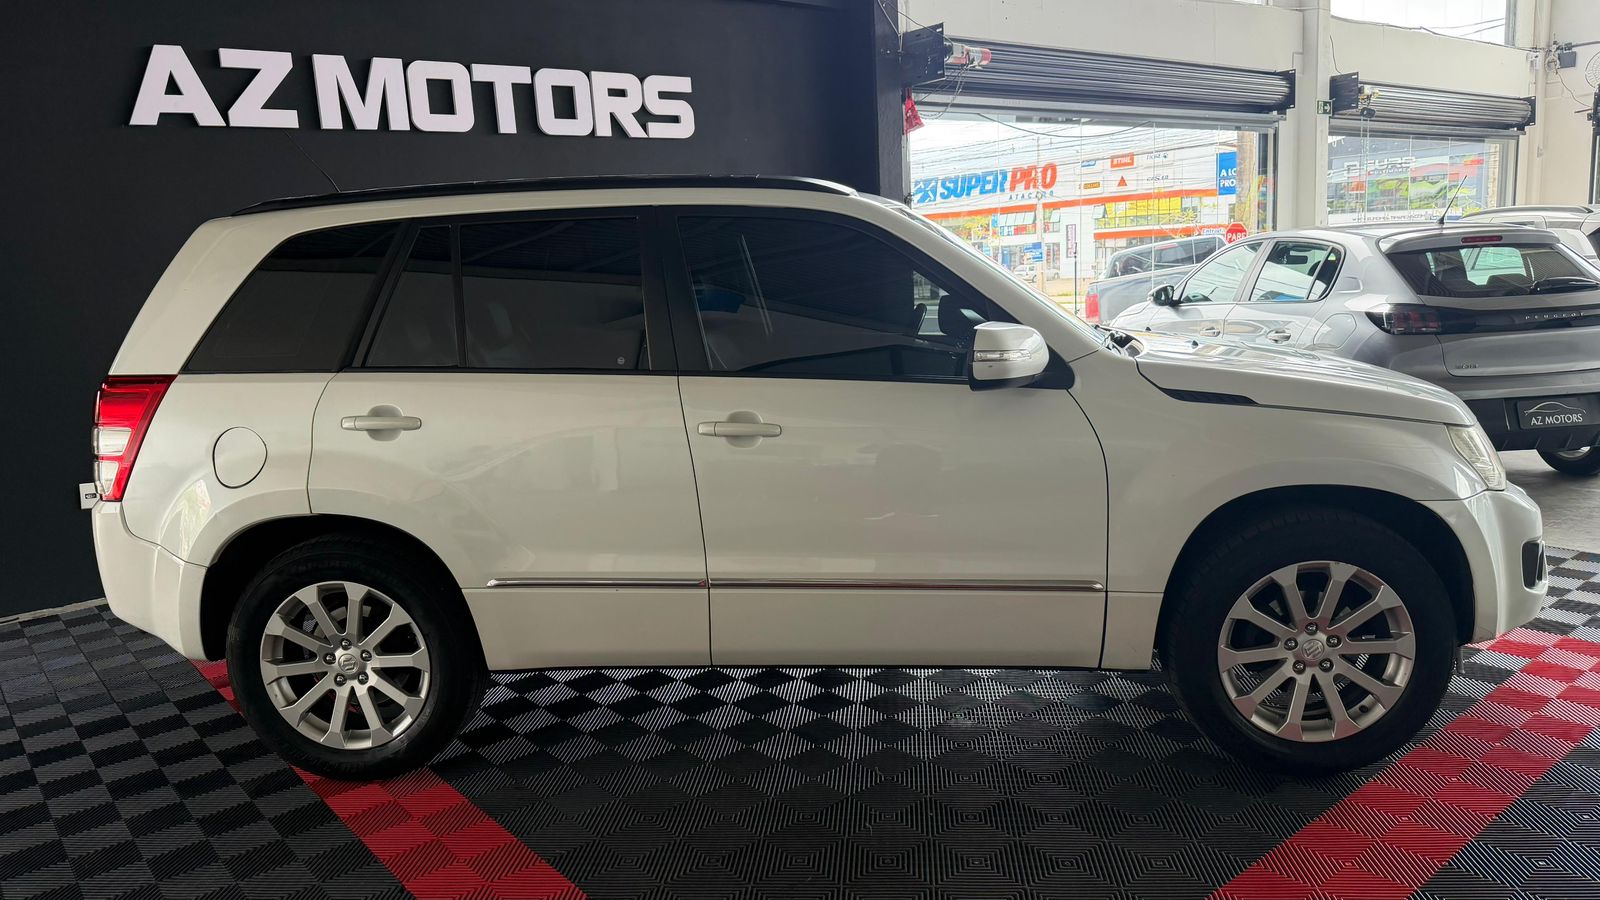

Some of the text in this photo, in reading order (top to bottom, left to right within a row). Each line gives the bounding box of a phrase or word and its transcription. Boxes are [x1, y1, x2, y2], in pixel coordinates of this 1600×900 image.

[129, 44, 695, 139] AZ MOTORS
[940, 162, 1057, 200] SUPER PRO
[1227, 231, 1247, 242] PARE
[1531, 413, 1583, 426] AZ MOTORS
